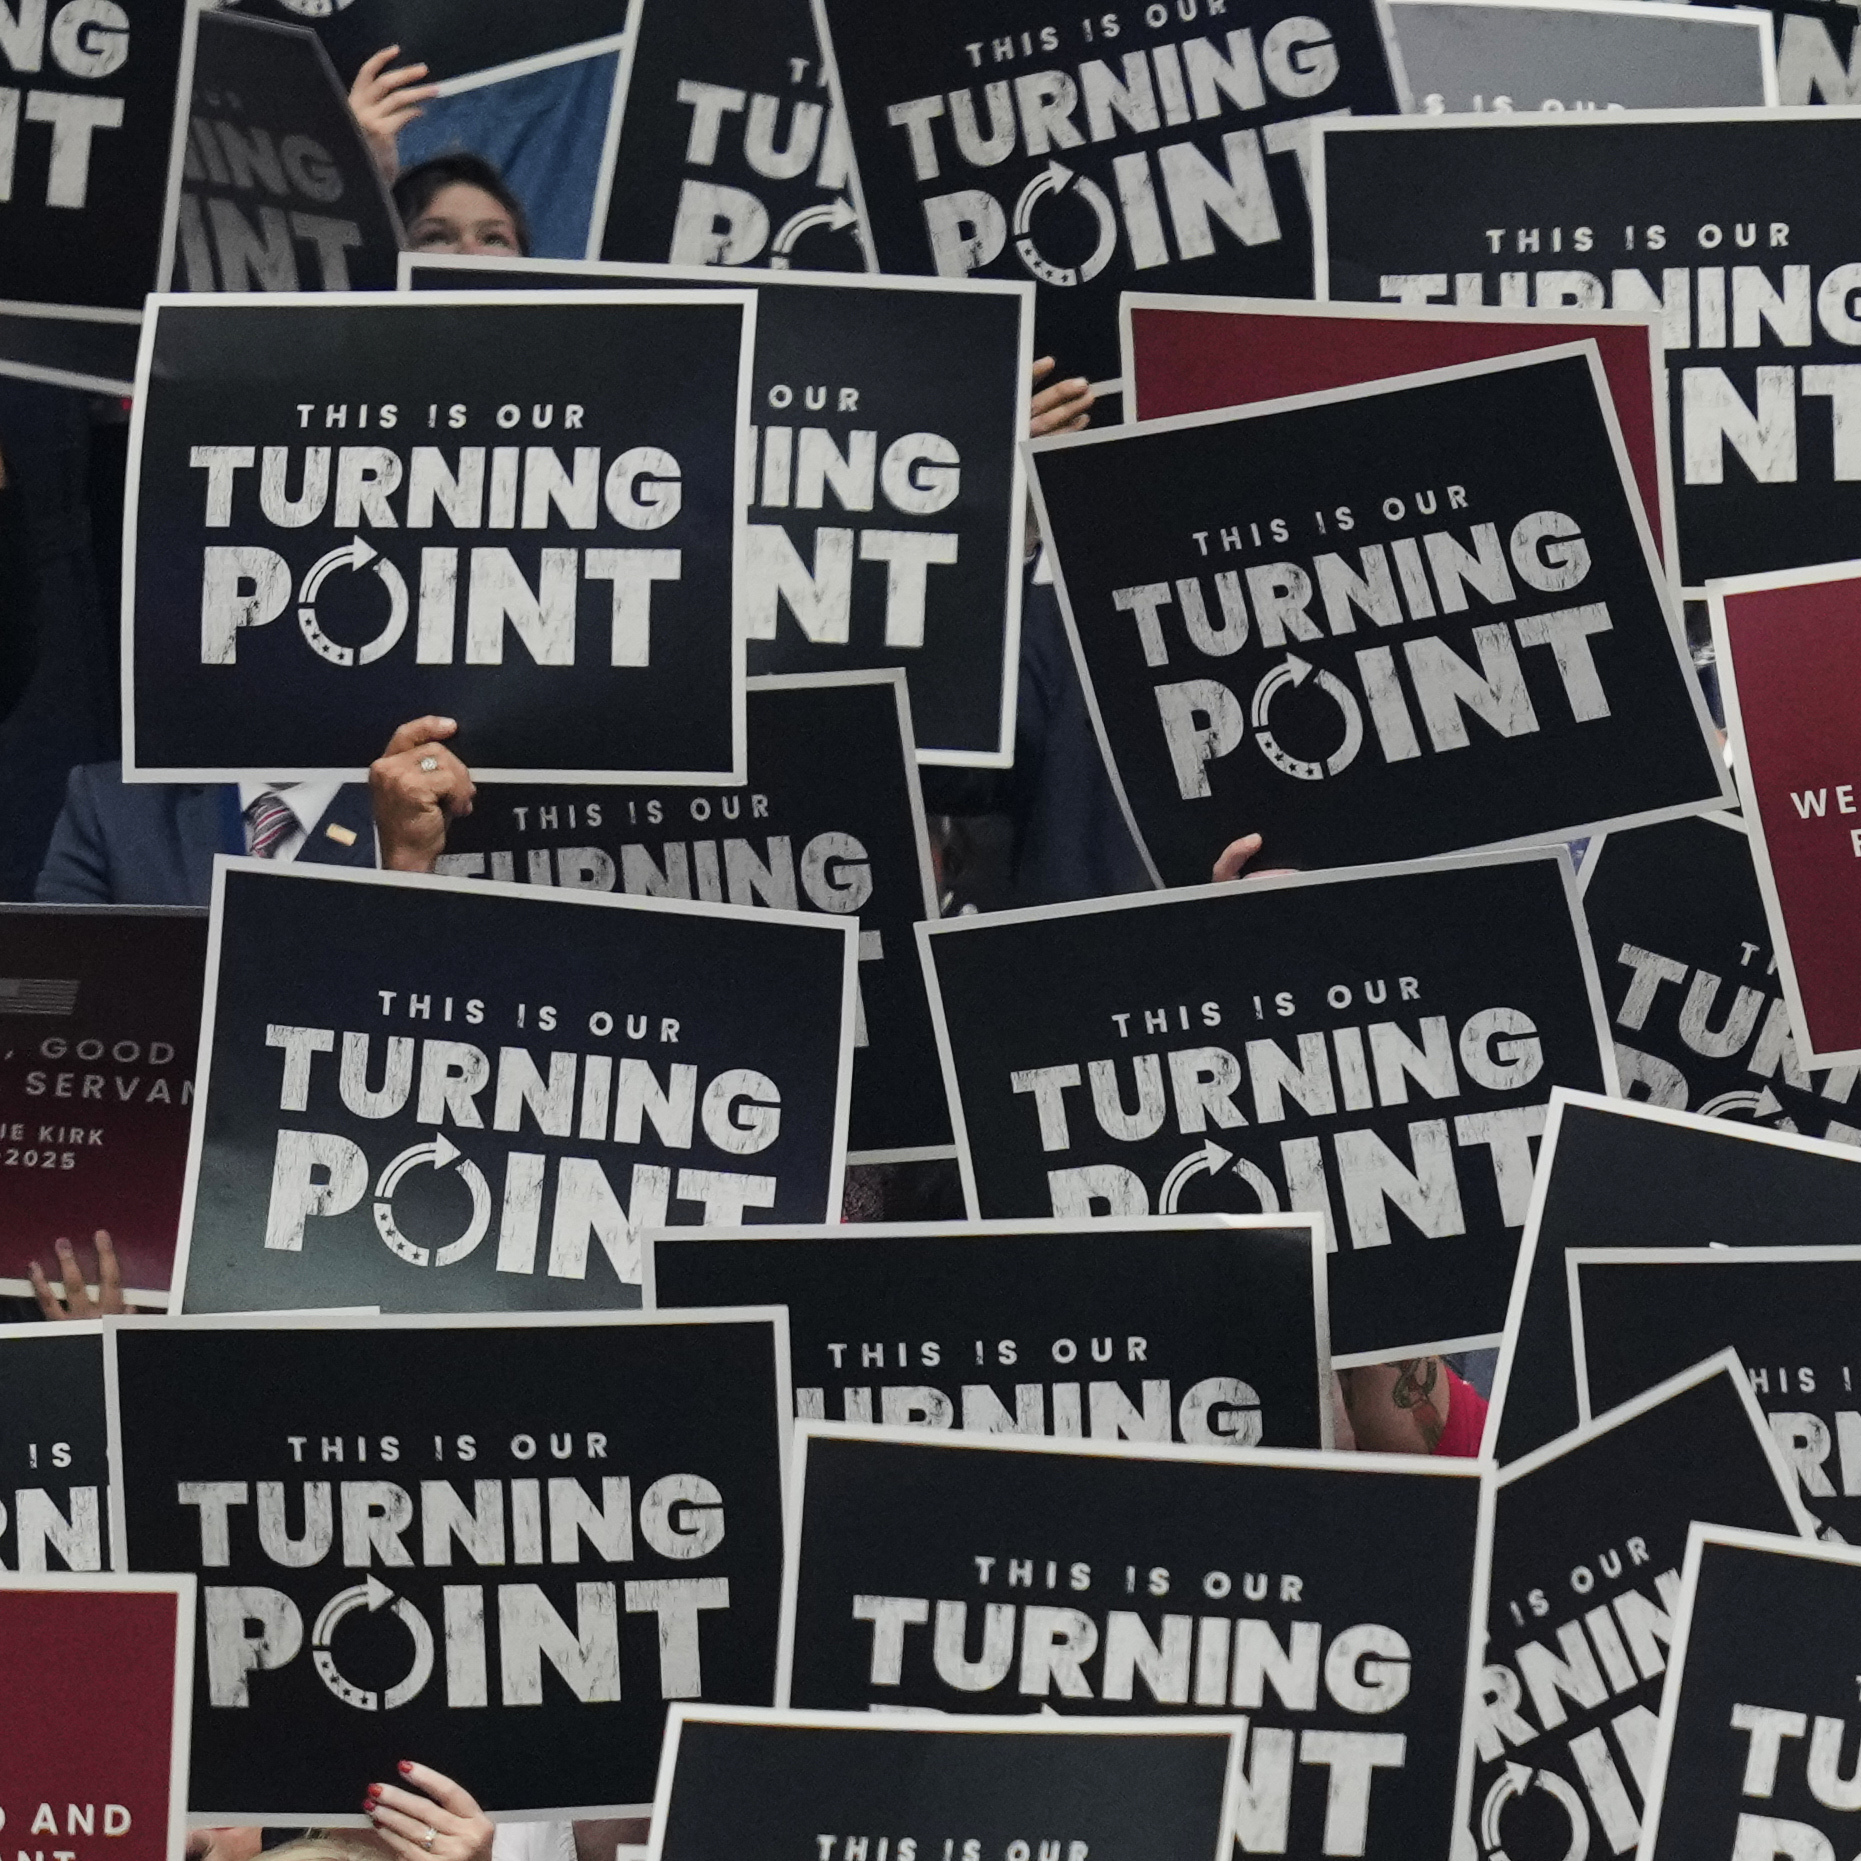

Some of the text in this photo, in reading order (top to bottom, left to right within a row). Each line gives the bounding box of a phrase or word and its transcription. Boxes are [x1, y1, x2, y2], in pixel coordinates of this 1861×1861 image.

[297, 404, 583, 429] THIS IS OUR
[190, 446, 681, 530] TURNING
[1193, 485, 1468, 555] THIS IS OUR
[201, 535, 681, 667] POINT
[1113, 507, 1601, 675] TURNING
[1154, 595, 1613, 799] POINT
[379, 991, 679, 1042] THIS IS OUR
[266, 1015, 781, 1164] TURNING
[288, 1432, 607, 1462] THIS IS OUR
[178, 1474, 724, 1567] TURNING
[205, 1574, 729, 1710] POINT
